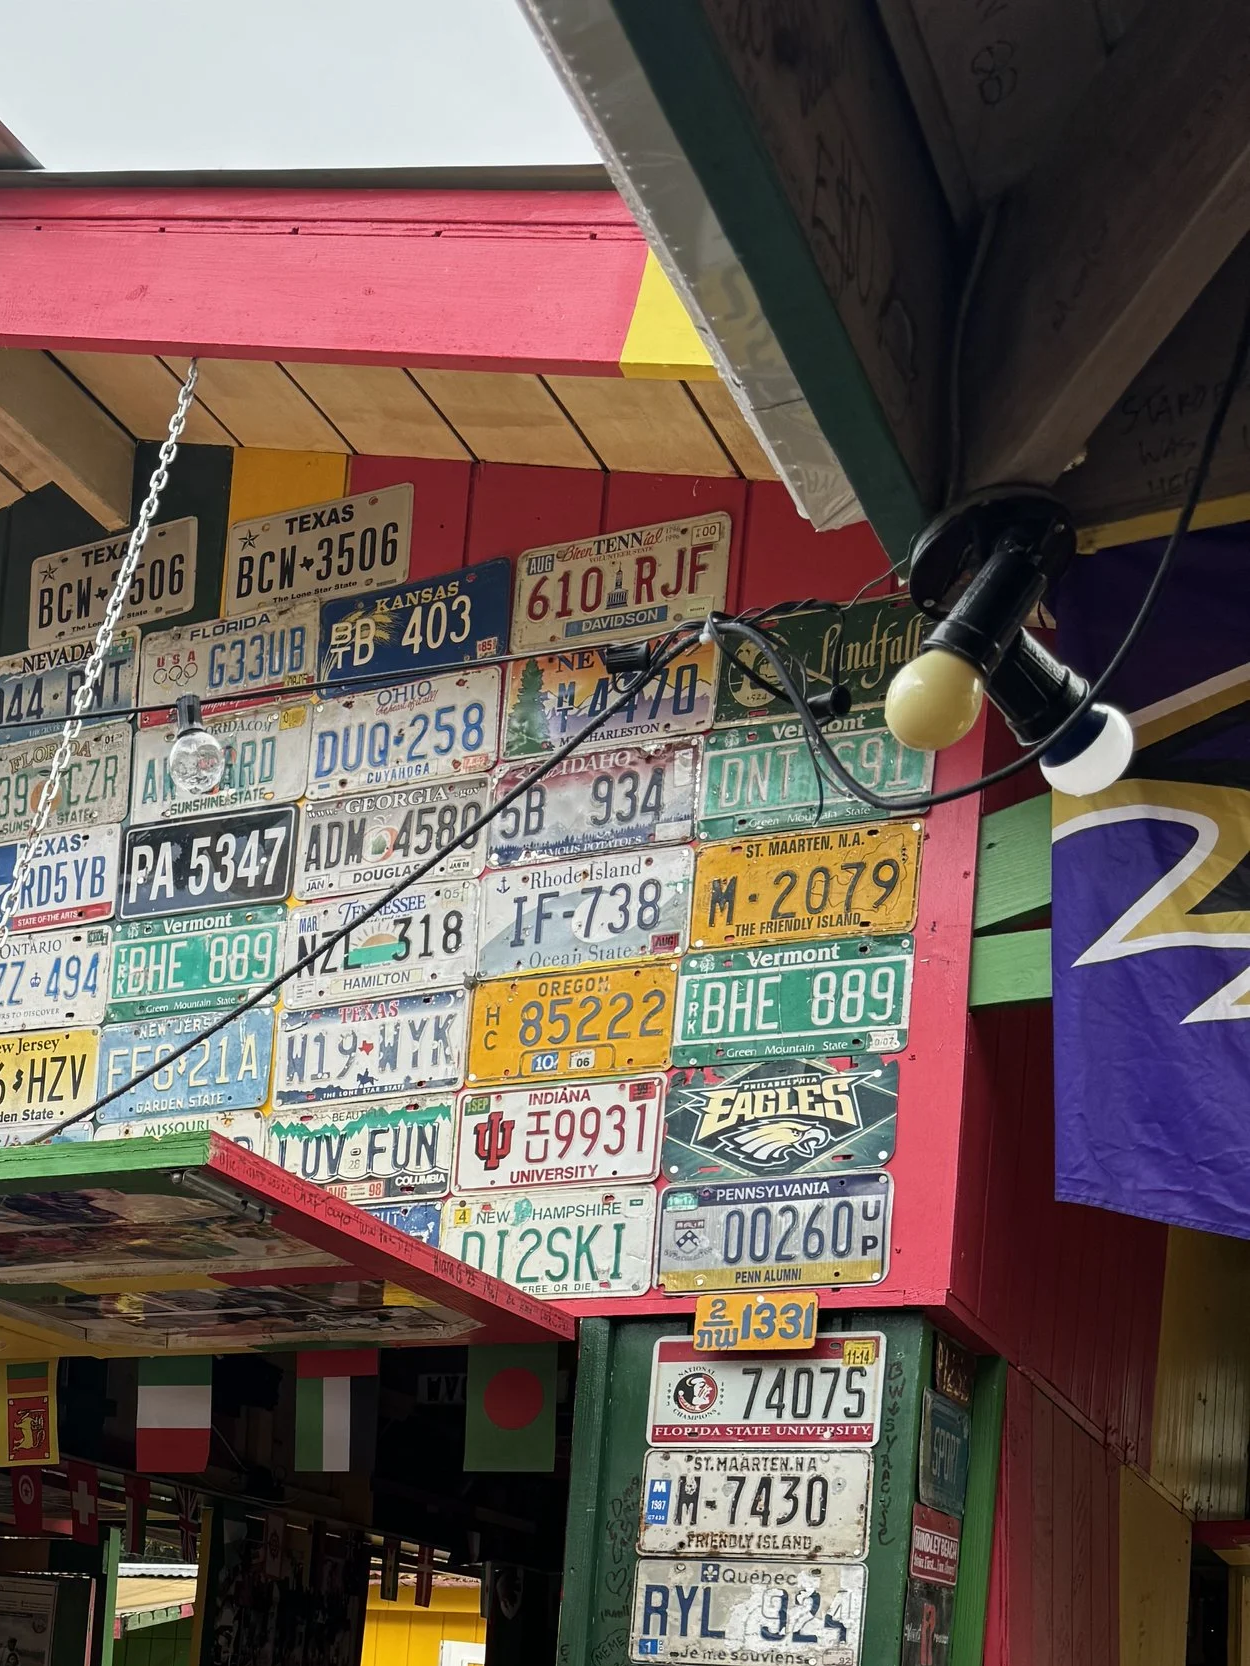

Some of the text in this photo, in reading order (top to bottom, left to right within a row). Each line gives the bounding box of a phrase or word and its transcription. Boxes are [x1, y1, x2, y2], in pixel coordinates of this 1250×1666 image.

[285, 504, 354, 537] TEXAS
[236, 522, 399, 599] BCW 3506
[528, 545, 713, 621] 610 RJF
[375, 581, 460, 612] KANSAS
[190, 614, 270, 641] FLORIDA
[402, 595, 472, 655] 403
[582, 611, 659, 633] DAVIDSON
[377, 682, 433, 706] OHIO
[314, 703, 485, 780] DUQ 258
[367, 763, 431, 785] CUYAHOGA
[128, 826, 286, 904] PA 5347
[162, 913, 232, 937] Vermont
[735, 910, 862, 937] THE FRIENDLY ISLAND
[747, 943, 841, 967] Vermont
[46, 954, 100, 1003] 494
[343, 973, 412, 992] HAMILTON
[538, 976, 611, 997] OREGON
[701, 966, 896, 1035] BHE 889
[518, 990, 667, 1046] 85222
[15, 1040, 61, 1060] Jersey
[726, 1036, 849, 1059] Green Mountain State
[743, 1076, 818, 1091] PHILADELPHIA
[527, 1088, 592, 1107] INDIANA
[701, 1077, 858, 1127] EAGLES
[21, 1108, 56, 1122] State
[552, 1104, 648, 1161] 9931
[509, 1164, 599, 1184] UNIVERSITY
[716, 1181, 830, 1201] PENNSYLVANIA
[723, 1199, 852, 1265] 00260
[735, 1266, 802, 1284] PENN ALUMNI
[678, 1365, 717, 1378] NATIONAL
[673, 1407, 719, 1422] CHAMPIONS
[722, 1568, 798, 1587] Québec
